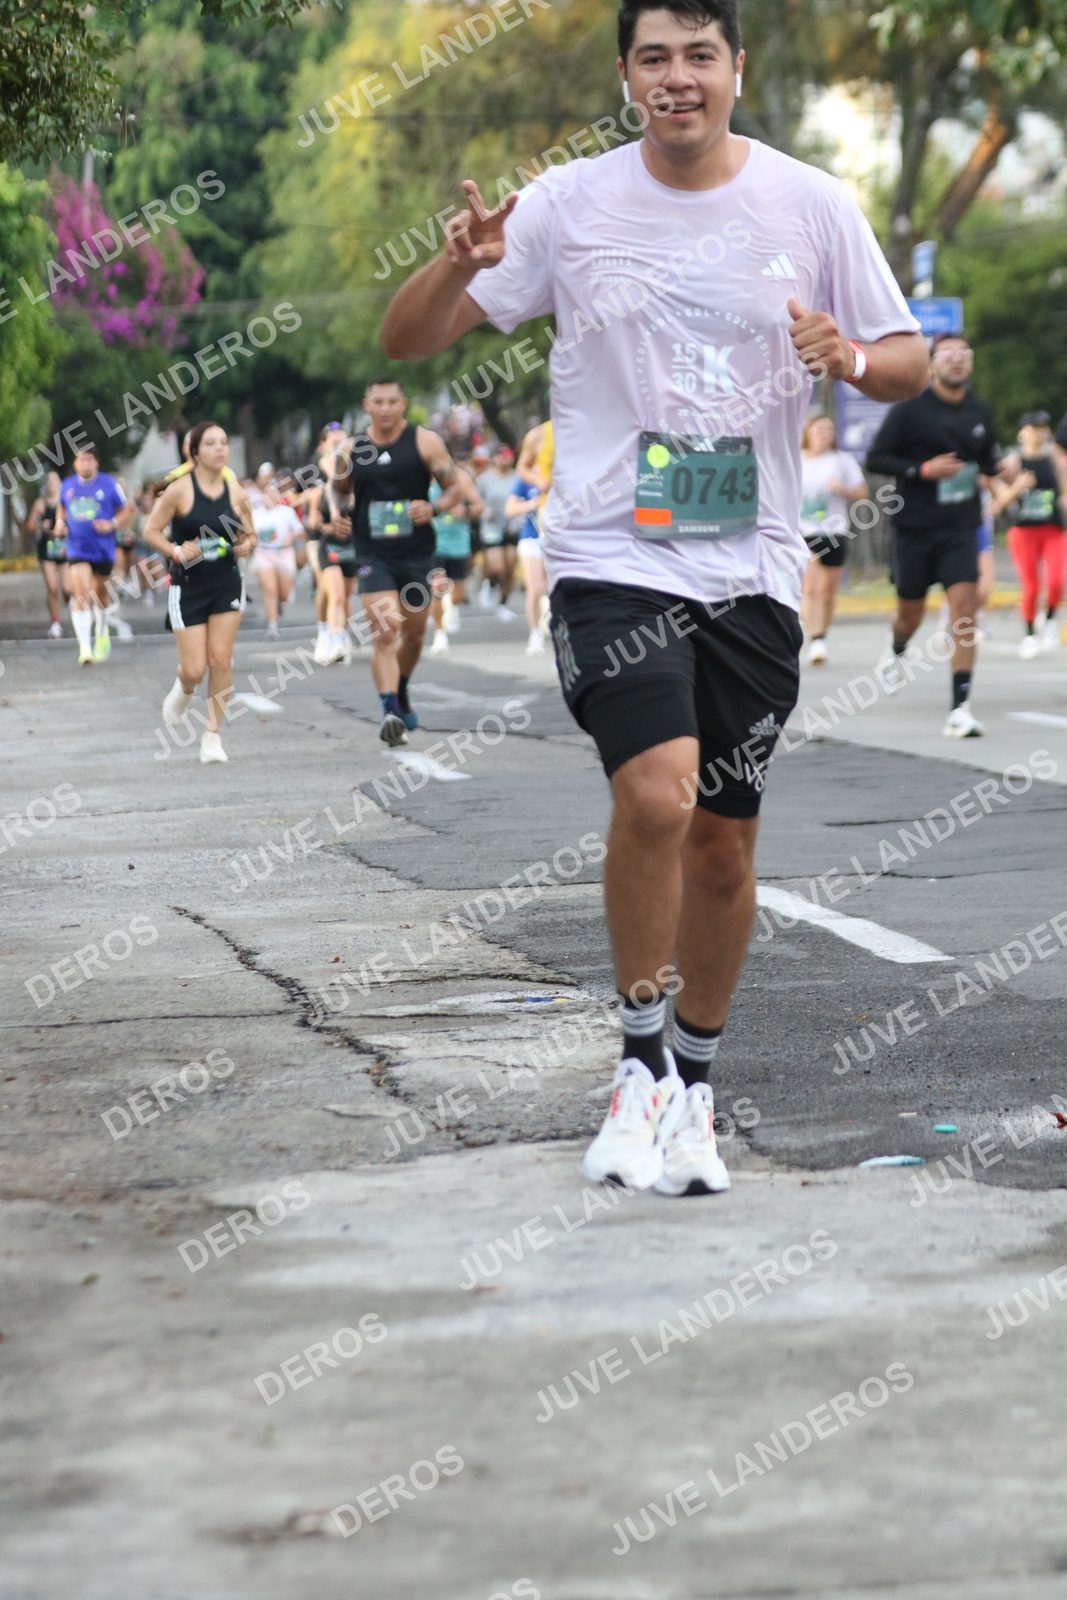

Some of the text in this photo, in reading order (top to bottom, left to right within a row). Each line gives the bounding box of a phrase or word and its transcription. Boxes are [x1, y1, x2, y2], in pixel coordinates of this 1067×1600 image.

[672, 343, 697, 363] 15
[703, 345, 735, 395] K
[672, 373, 697, 393] 30
[673, 466, 756, 505] 0743
[678, 525, 720, 533] SAMSUNG
